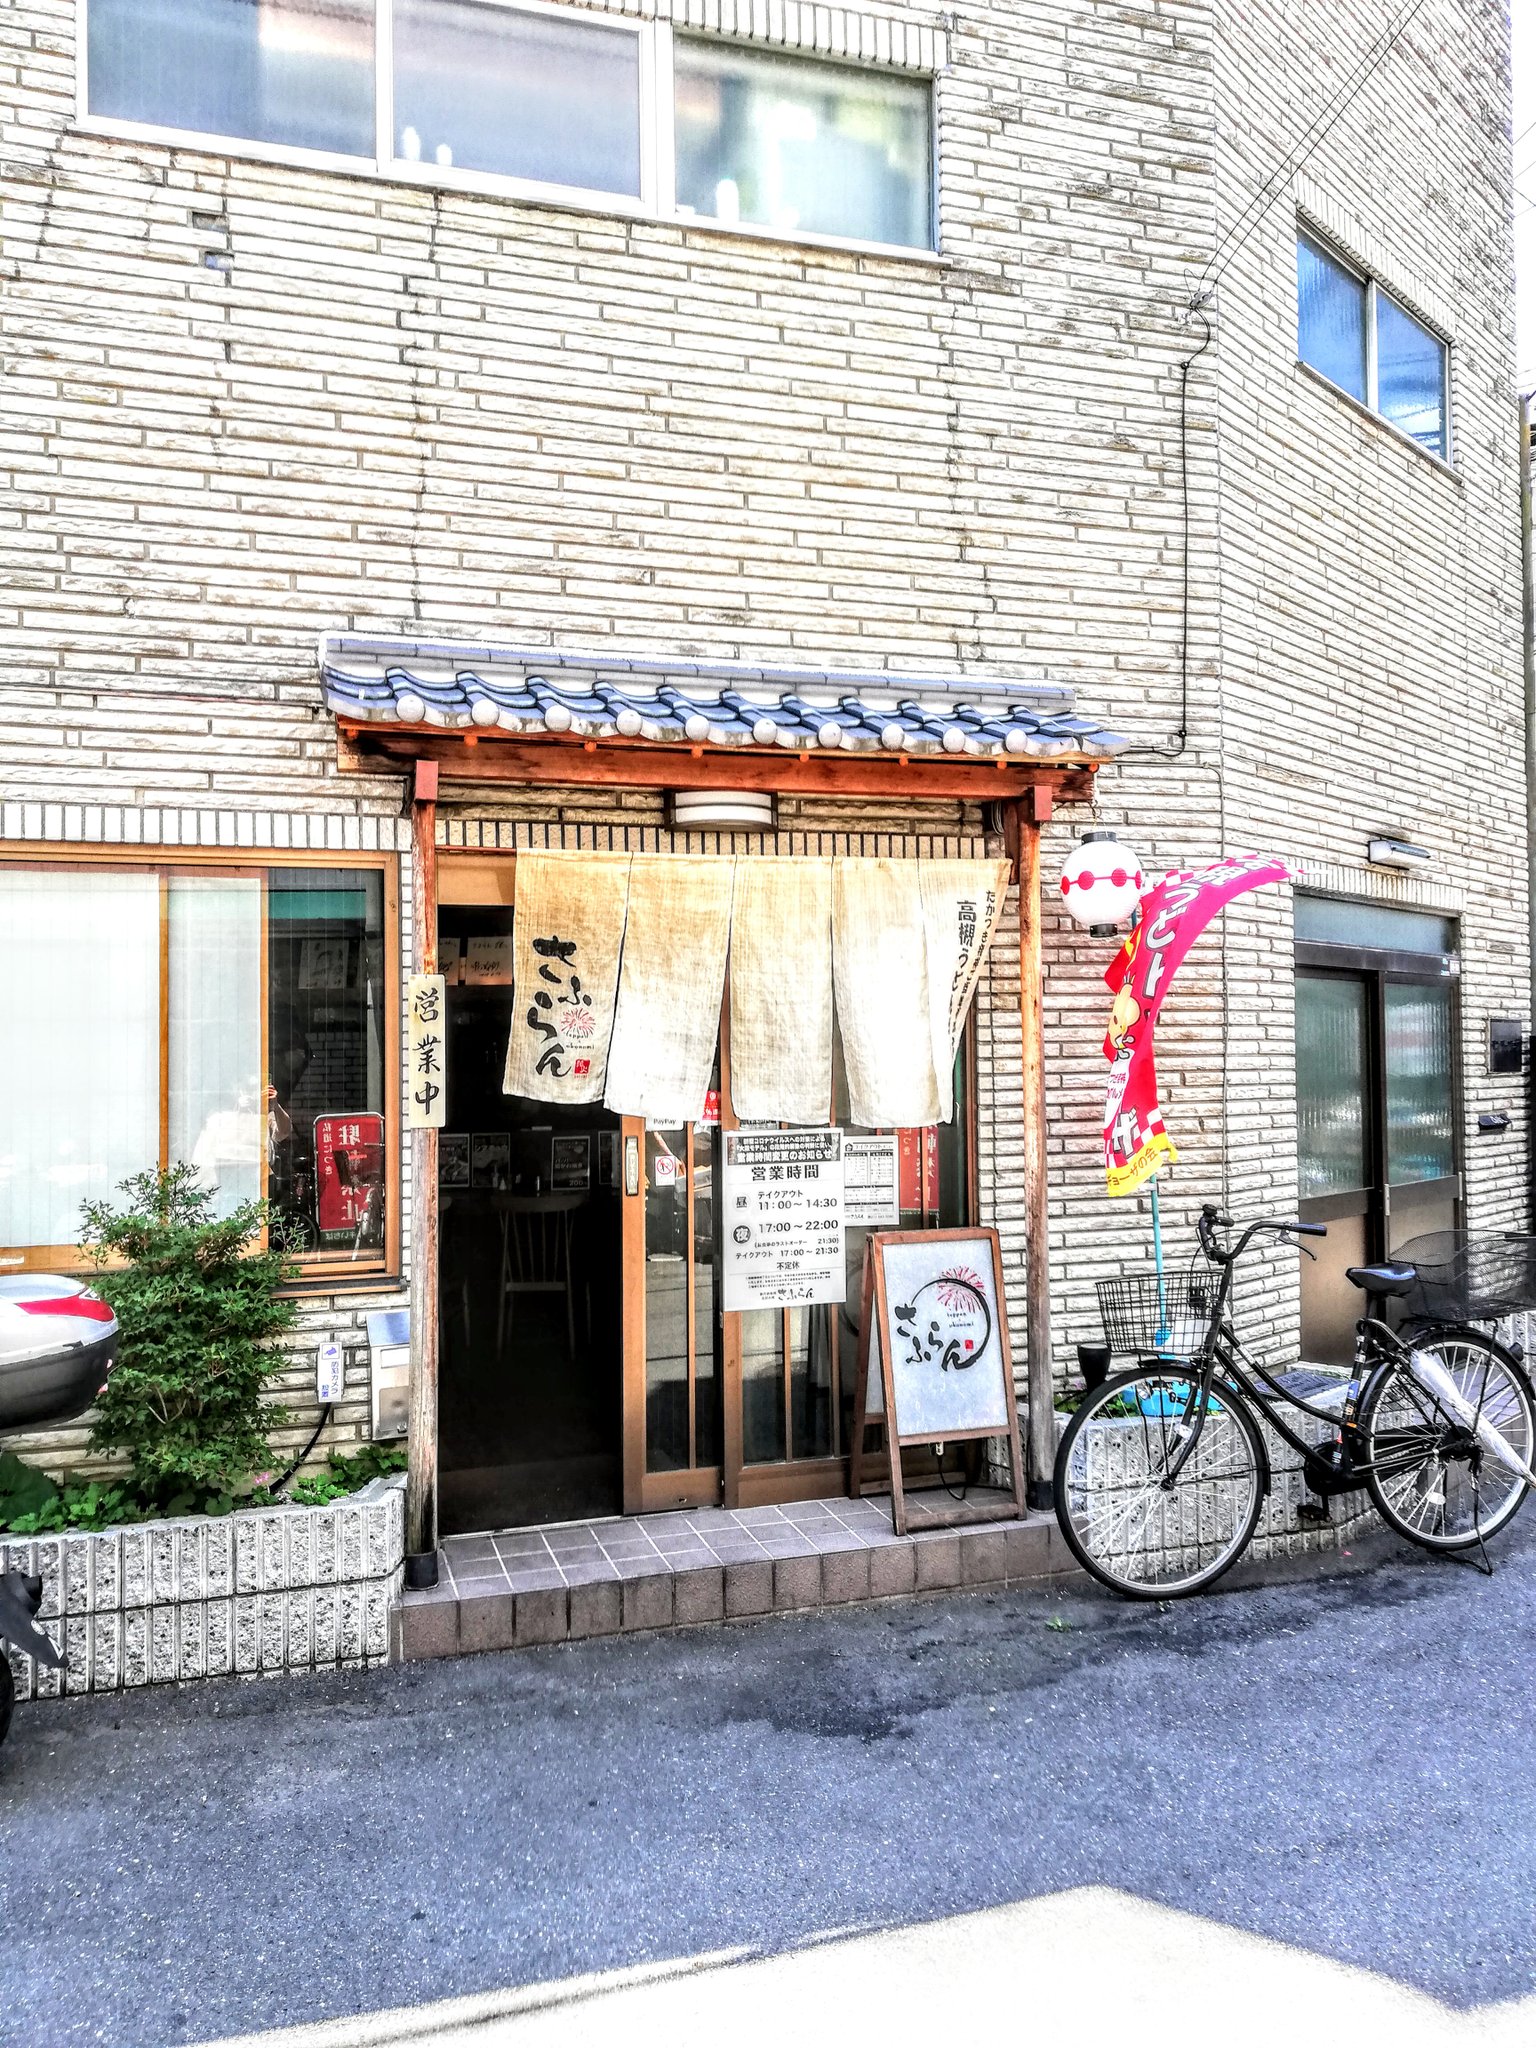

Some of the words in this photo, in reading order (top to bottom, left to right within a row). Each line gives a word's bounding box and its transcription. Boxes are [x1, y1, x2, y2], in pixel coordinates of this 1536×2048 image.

[412, 987, 442, 1116] 営業中
[737, 1149, 832, 1163] 営業時間変更のお知らせ
[751, 1164, 819, 1181] 営業時間
[758, 1189, 803, 1200] テイクアウト
[736, 1196, 747, 1208] 昼
[736, 1250, 773, 1260] テイクアウト
[777, 1261, 800, 1270] 不定休
